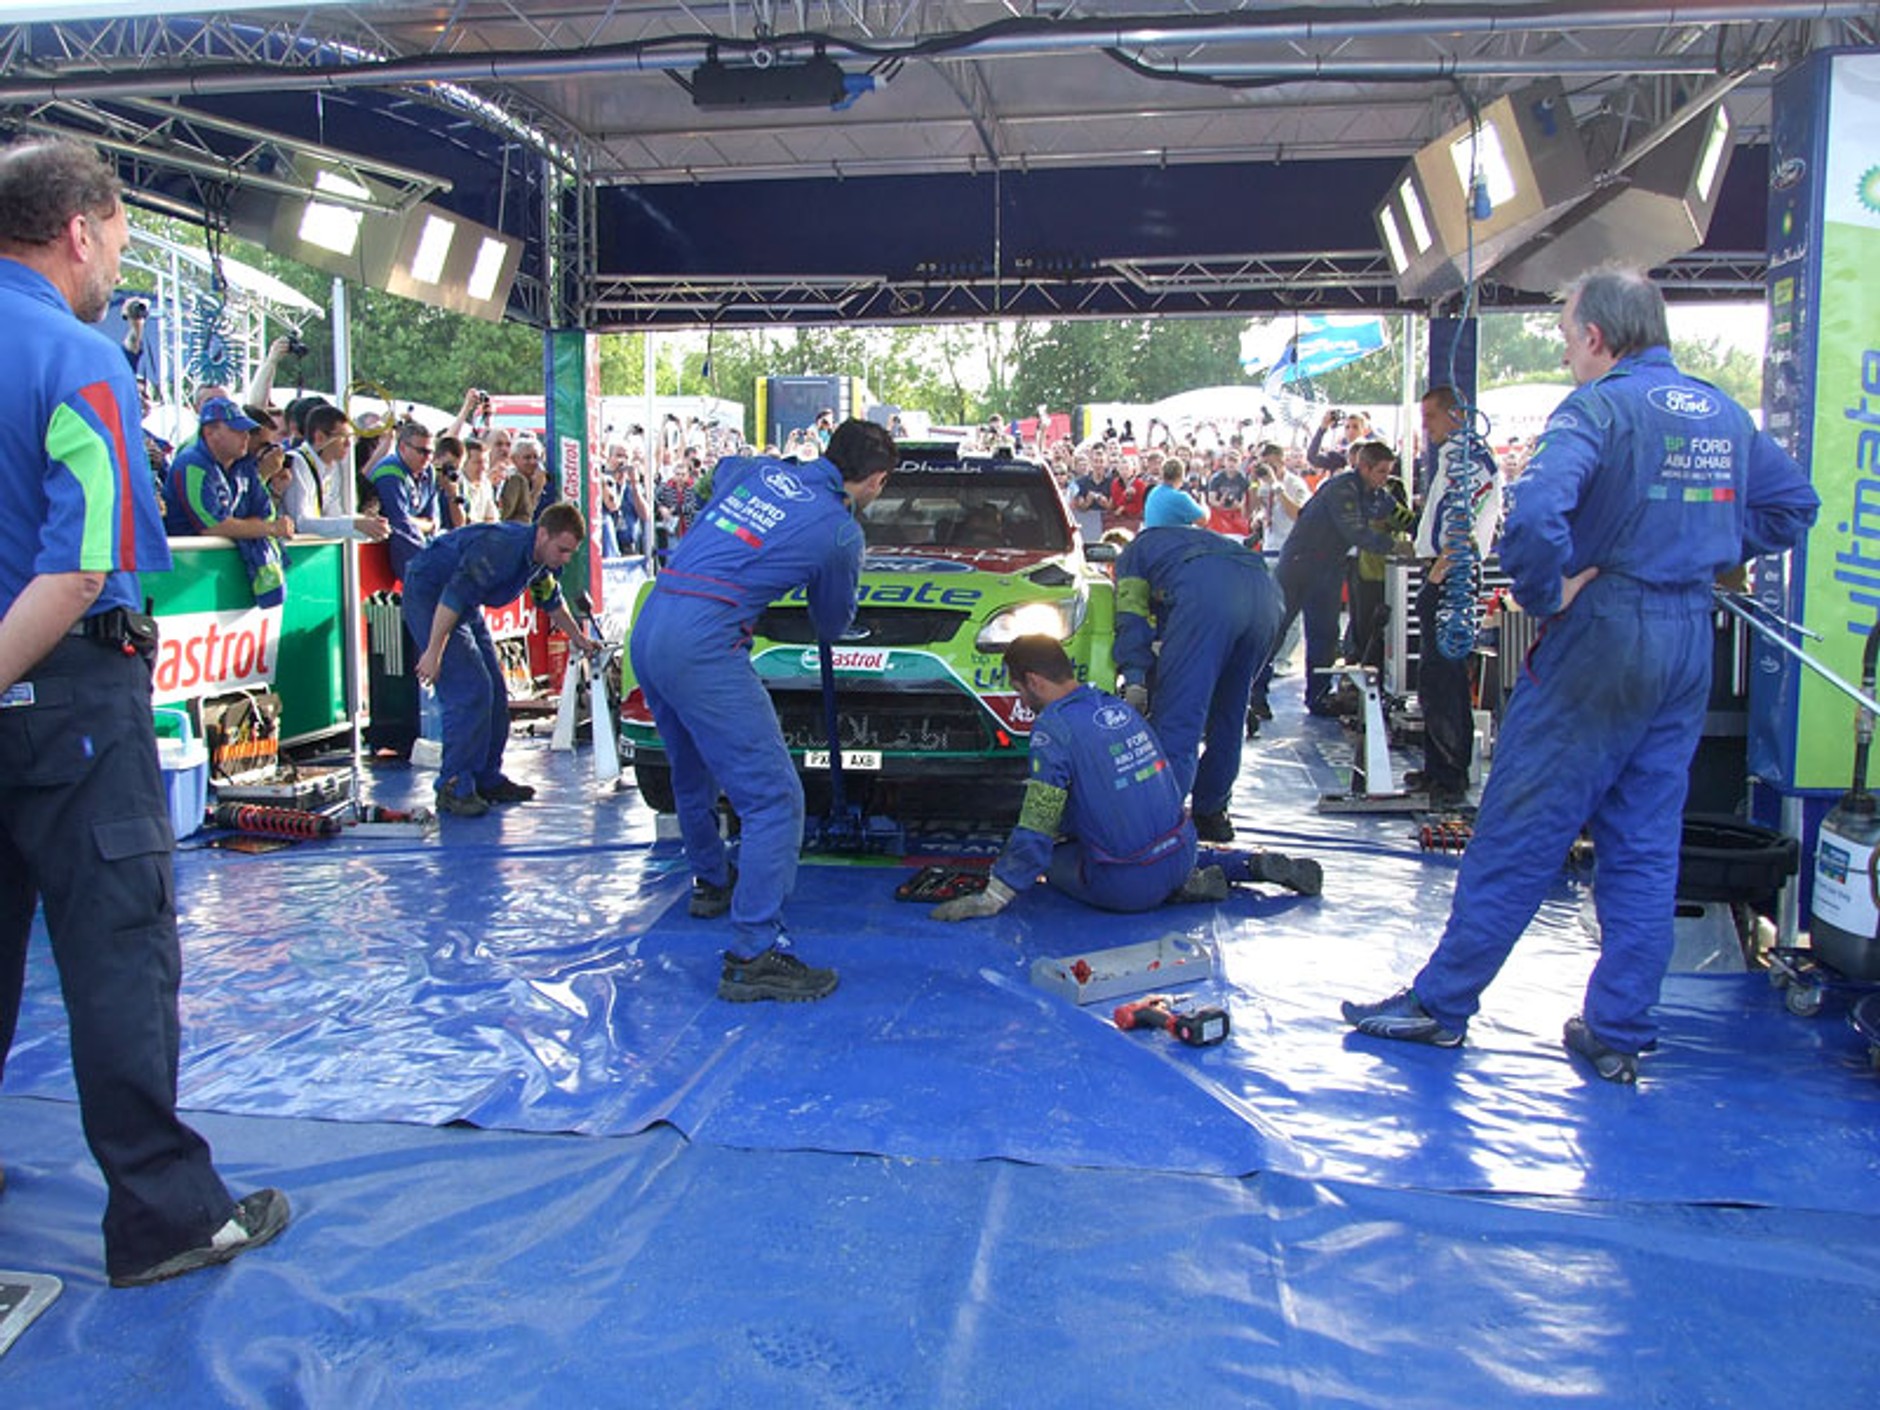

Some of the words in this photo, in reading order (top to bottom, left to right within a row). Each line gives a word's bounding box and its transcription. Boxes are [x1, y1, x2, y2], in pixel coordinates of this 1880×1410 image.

[1666, 389, 1712, 413] Ford
[1690, 438, 1731, 454] FORD
[563, 442, 579, 499] Castrol
[1664, 453, 1691, 469] ABU
[1694, 455, 1731, 469] DHABI
[156, 618, 269, 692] astrol
[831, 650, 882, 668] astrol
